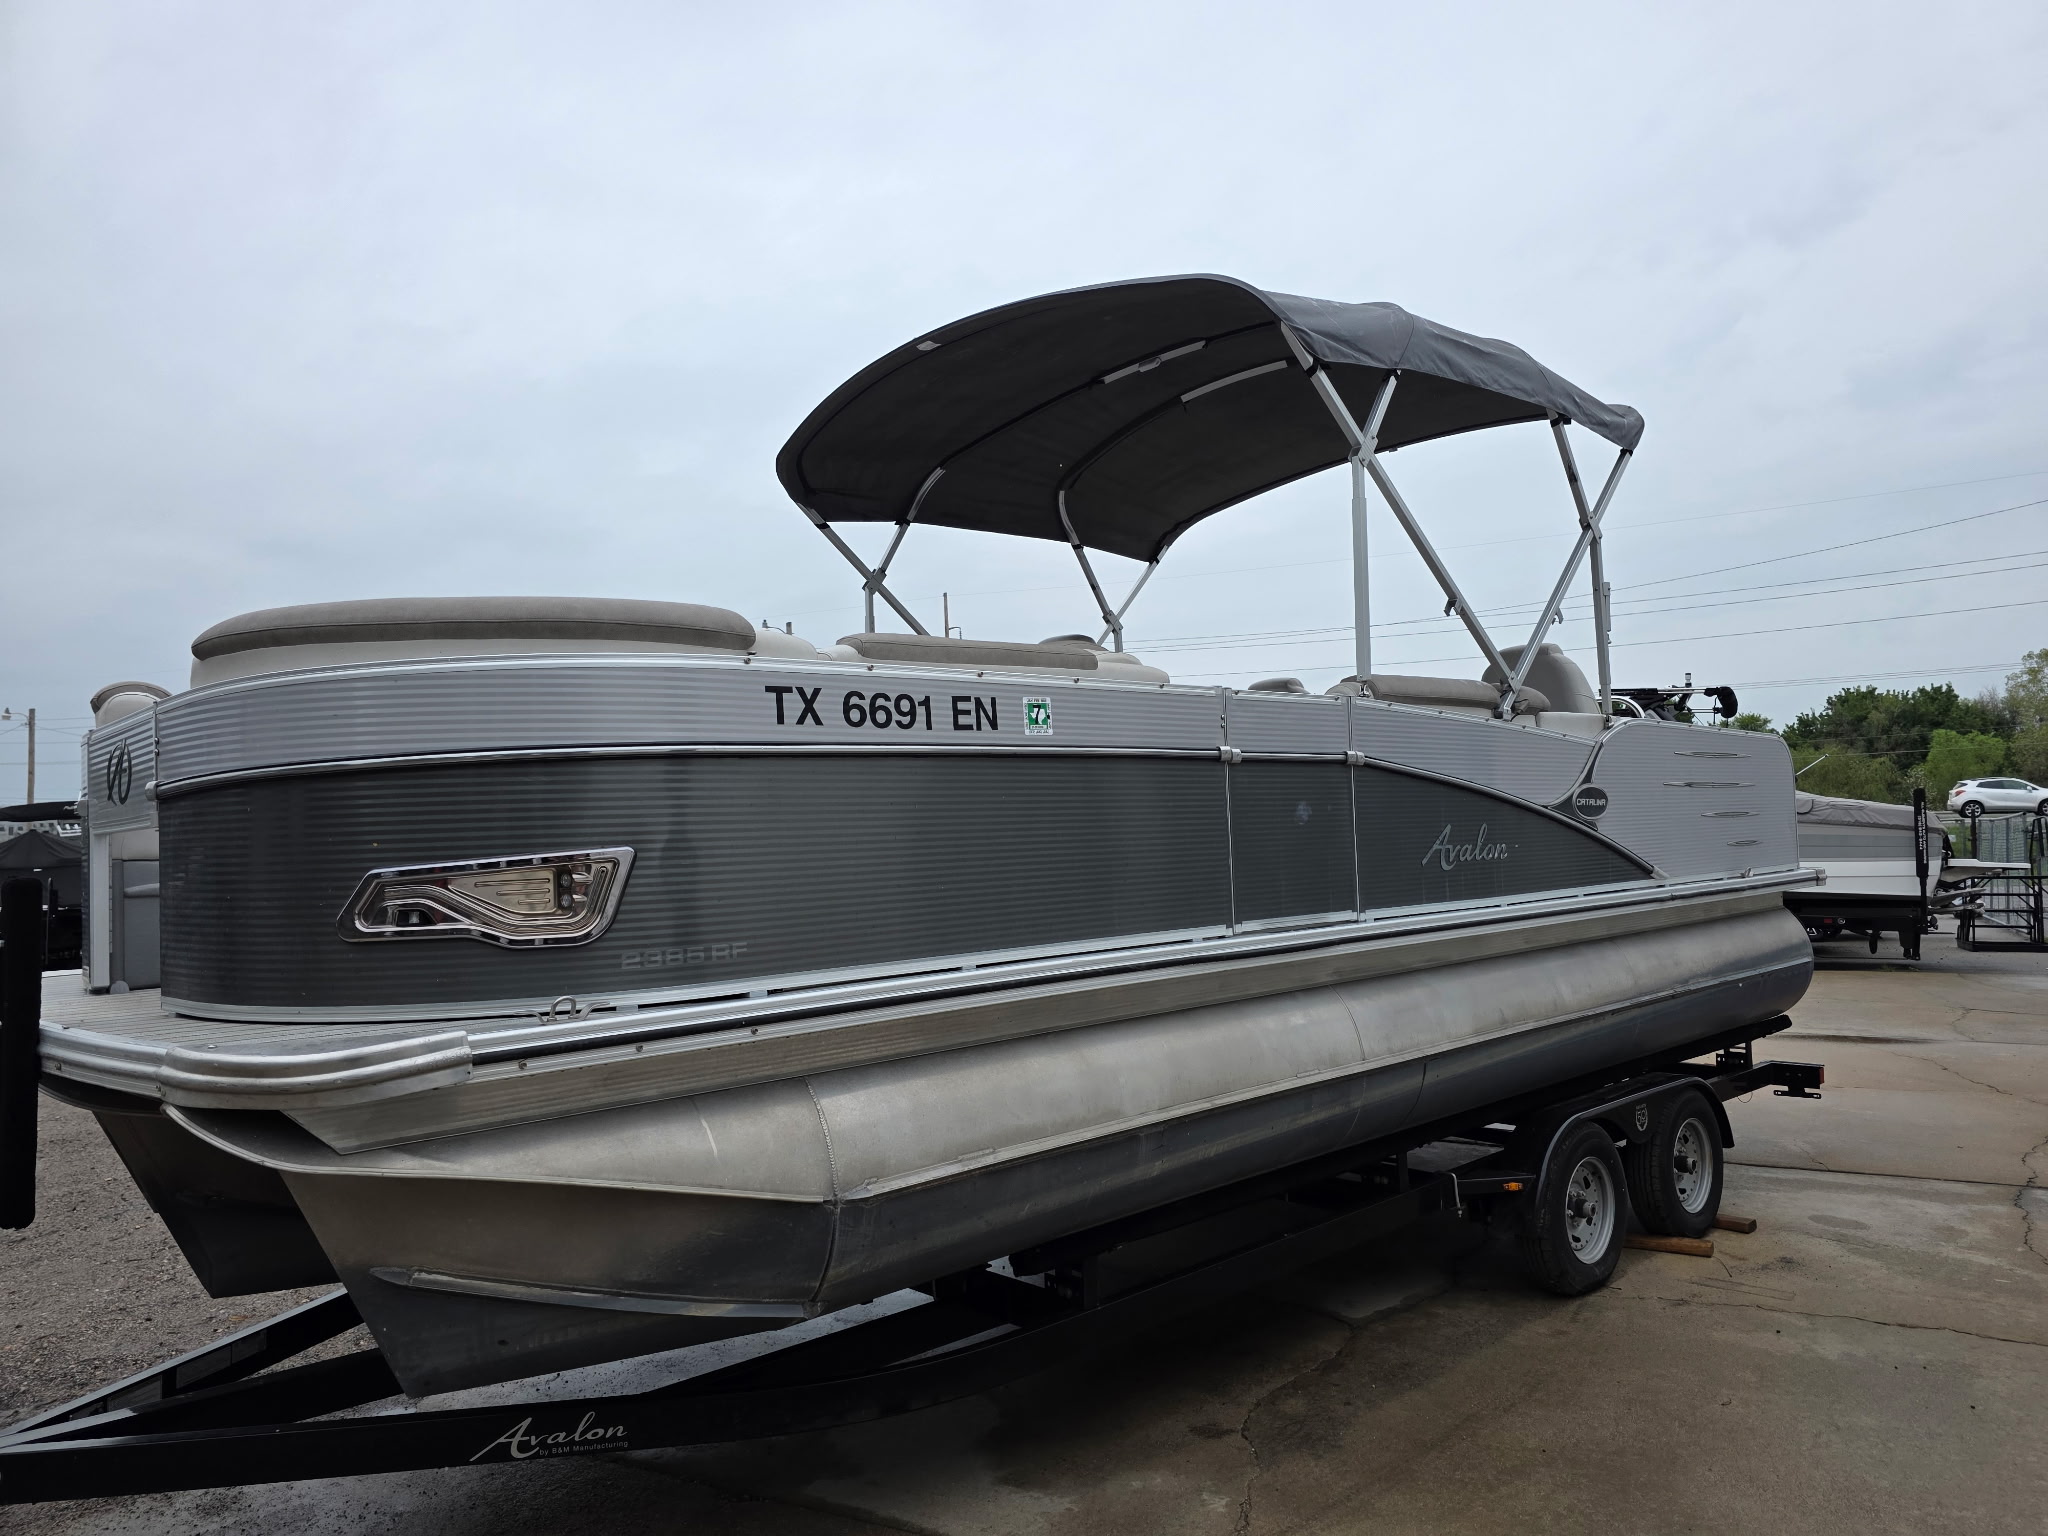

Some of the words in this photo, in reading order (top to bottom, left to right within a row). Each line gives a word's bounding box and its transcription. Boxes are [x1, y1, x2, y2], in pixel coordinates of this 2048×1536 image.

[765, 685, 824, 726] TX
[842, 690, 933, 731] 6691
[951, 695, 999, 731] EN
[1576, 798, 1606, 806] CATALINA
[1421, 823, 1508, 871] Avalon
[621, 946, 705, 970] 2385
[711, 941, 748, 962] RF
[468, 1411, 628, 1459] Avalon
[539, 1448, 549, 1456] by
[552, 1446, 570, 1454] B&M
[573, 1441, 629, 1452] Manufacturing
